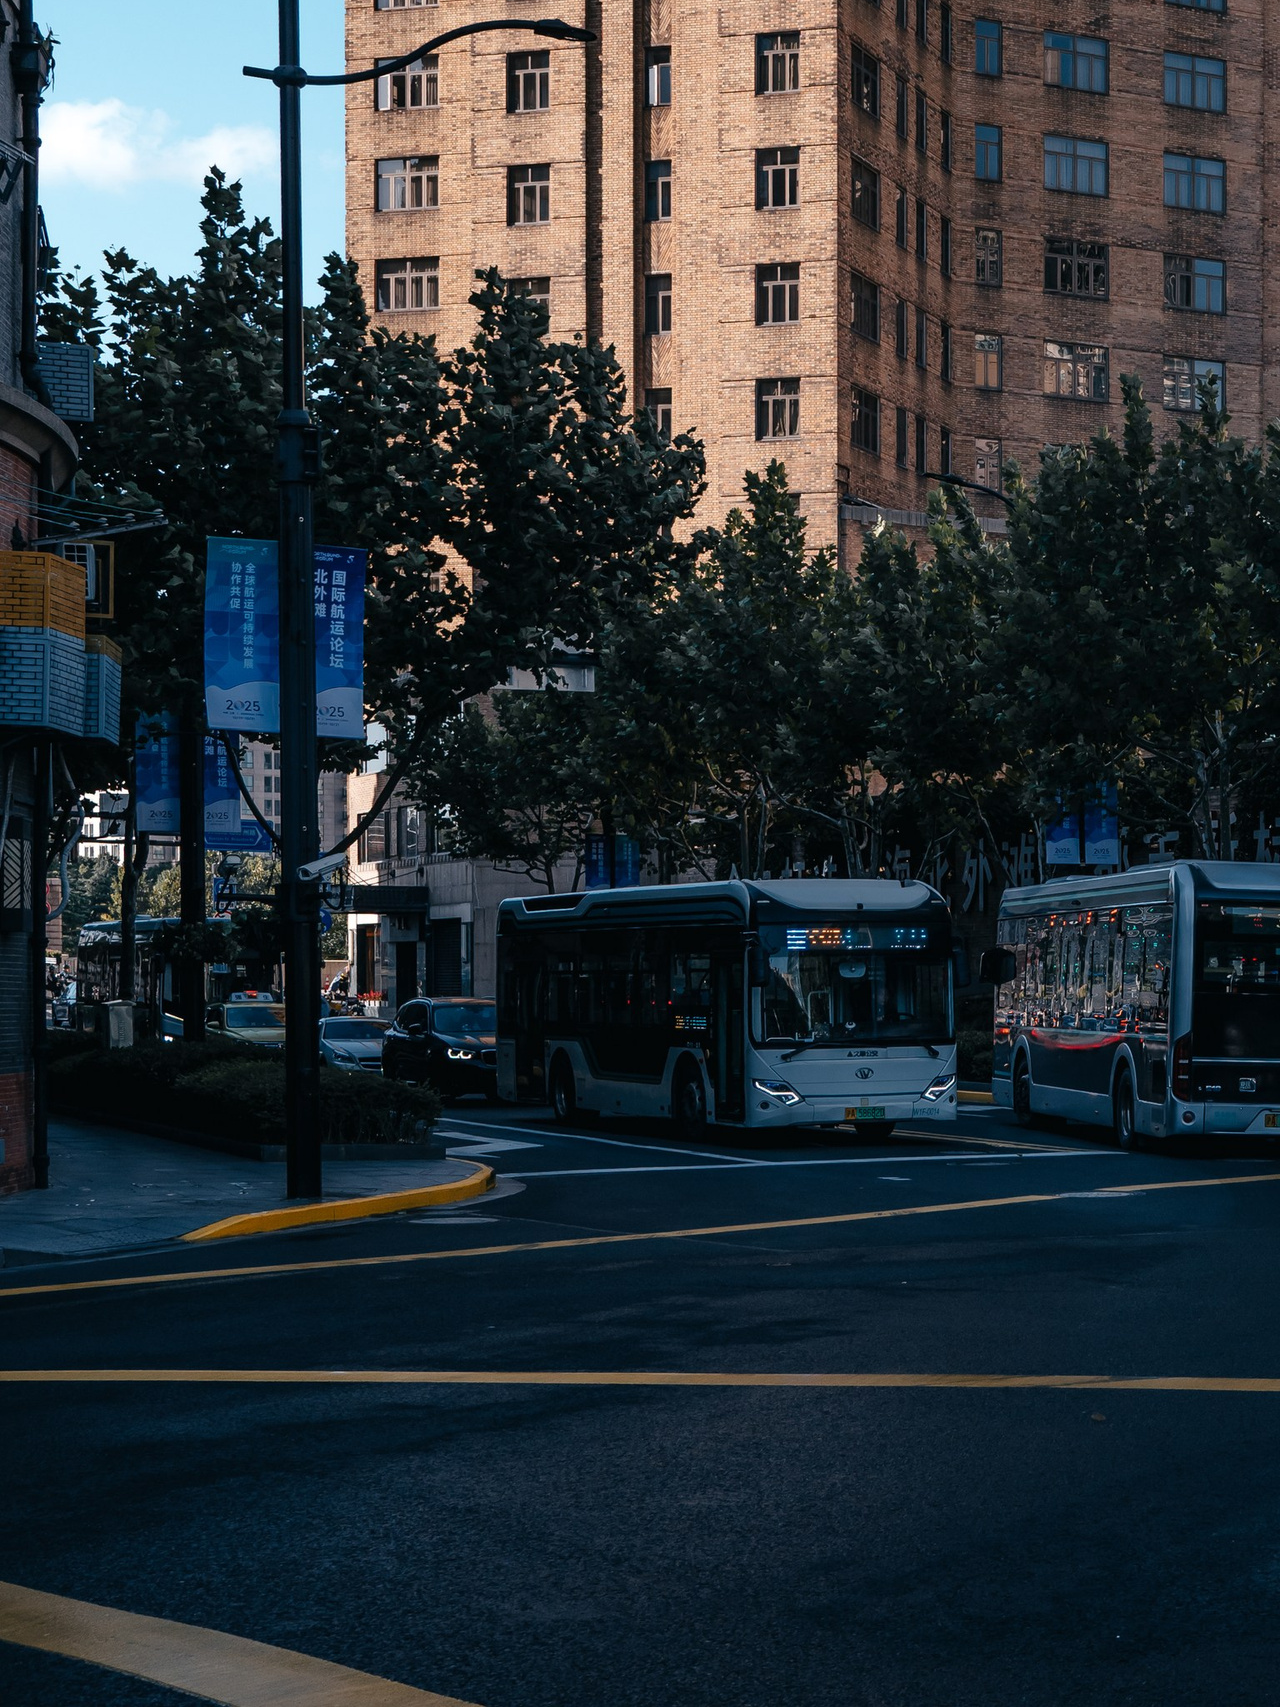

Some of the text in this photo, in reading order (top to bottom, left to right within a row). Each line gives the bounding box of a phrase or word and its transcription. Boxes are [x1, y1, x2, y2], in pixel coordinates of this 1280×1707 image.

[229, 561, 242, 609] 协作共促
[243, 562, 256, 669] 全球航运可持续发展
[329, 570, 346, 669] 国际航运论坛
[226, 699, 261, 712] 2025
[204, 733, 214, 756] 外滩
[206, 811, 229, 820] 2025
